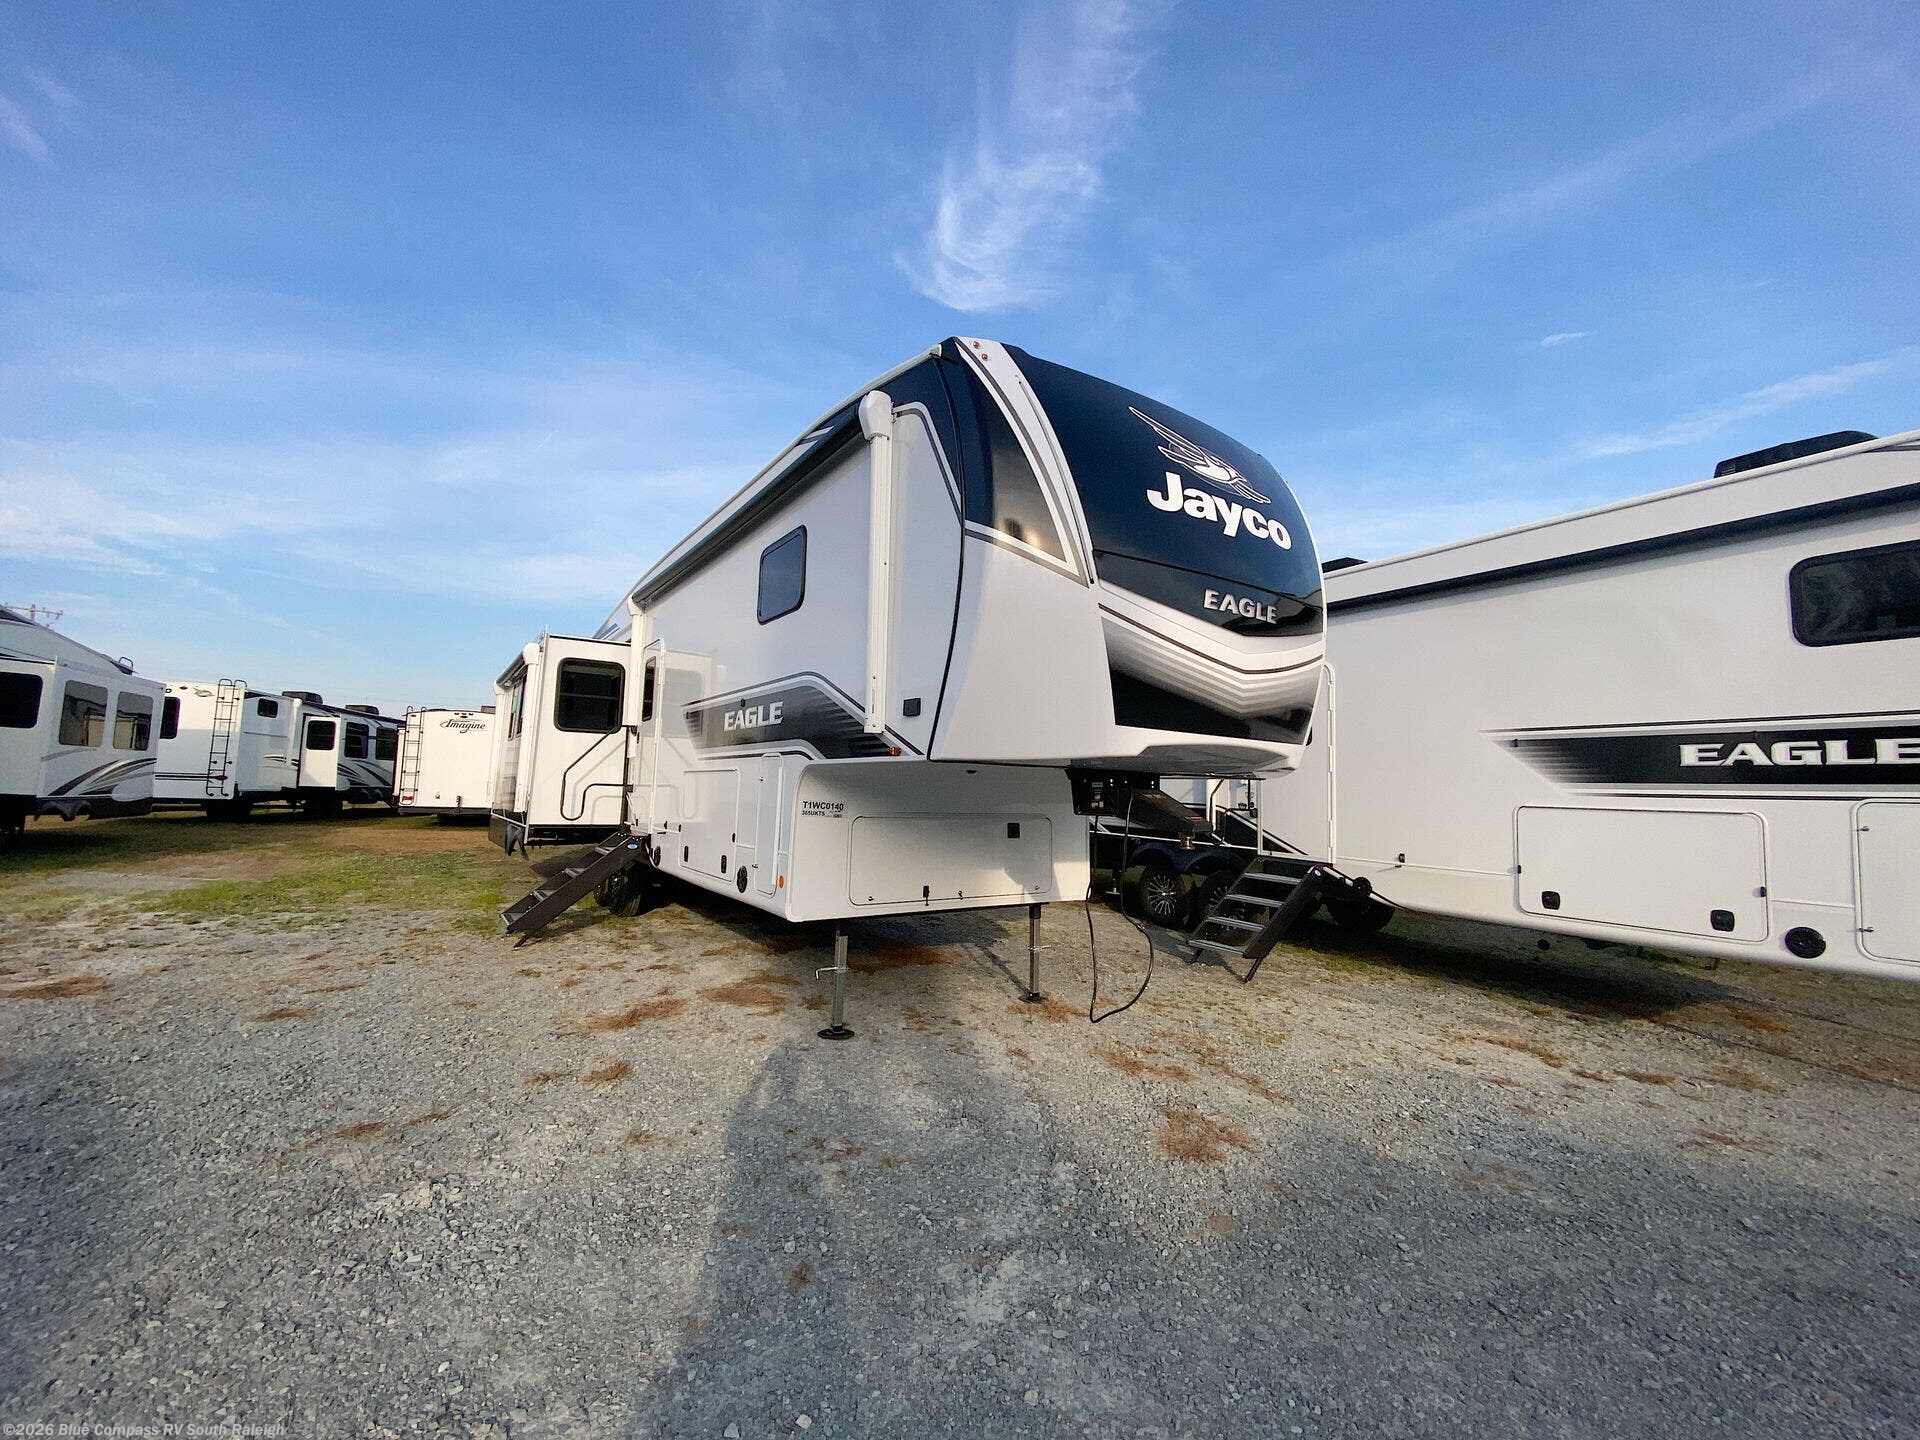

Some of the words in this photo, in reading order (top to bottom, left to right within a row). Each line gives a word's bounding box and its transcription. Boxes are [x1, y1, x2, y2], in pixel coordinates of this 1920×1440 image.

[1146, 471, 1292, 550] Jayco
[1203, 588, 1278, 624] EAGLE
[440, 718, 486, 734] Imagine
[723, 701, 784, 732] EAGLE
[1679, 737, 1920, 767] EAGLE
[802, 800, 844, 811] T1WC0140
